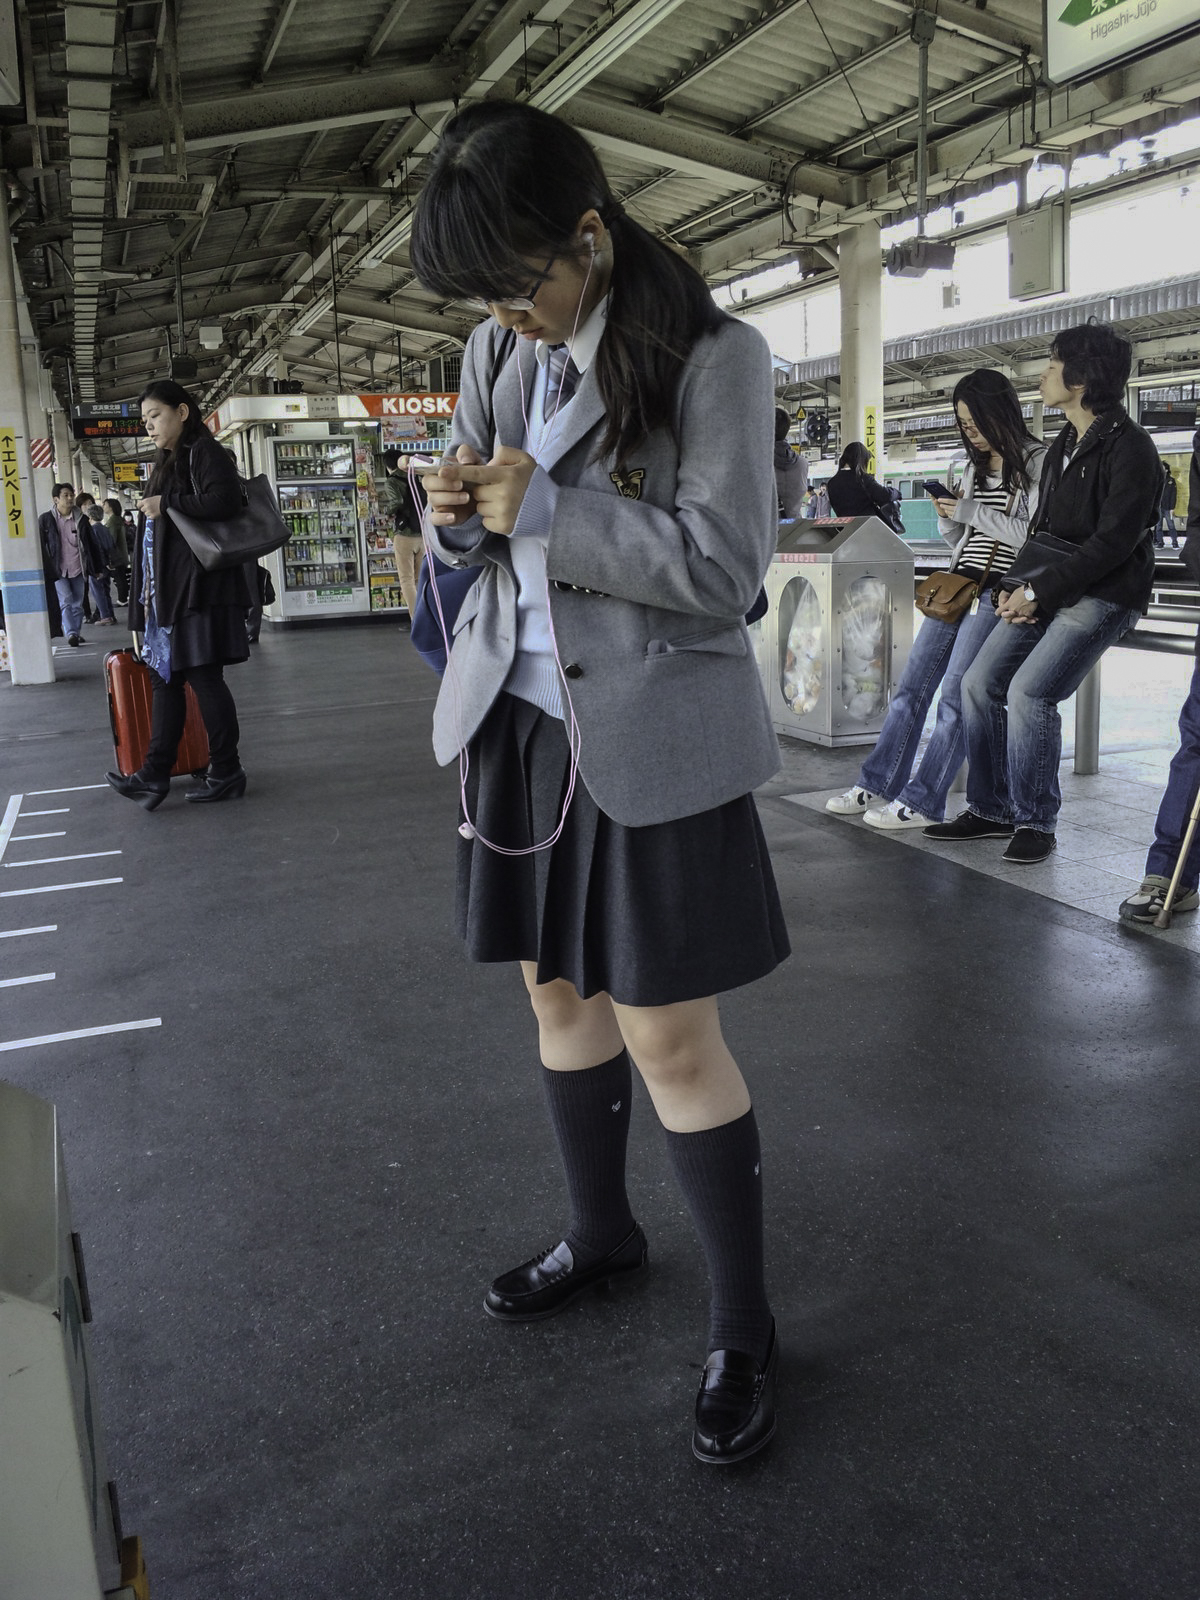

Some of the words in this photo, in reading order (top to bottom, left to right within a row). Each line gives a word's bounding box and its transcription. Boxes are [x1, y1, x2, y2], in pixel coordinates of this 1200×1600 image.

[75, 405, 81, 417] 1
[382, 397, 452, 414] KIOSK
[1143, 402, 1149, 410] 3
[2, 450, 22, 536] エレベーター
